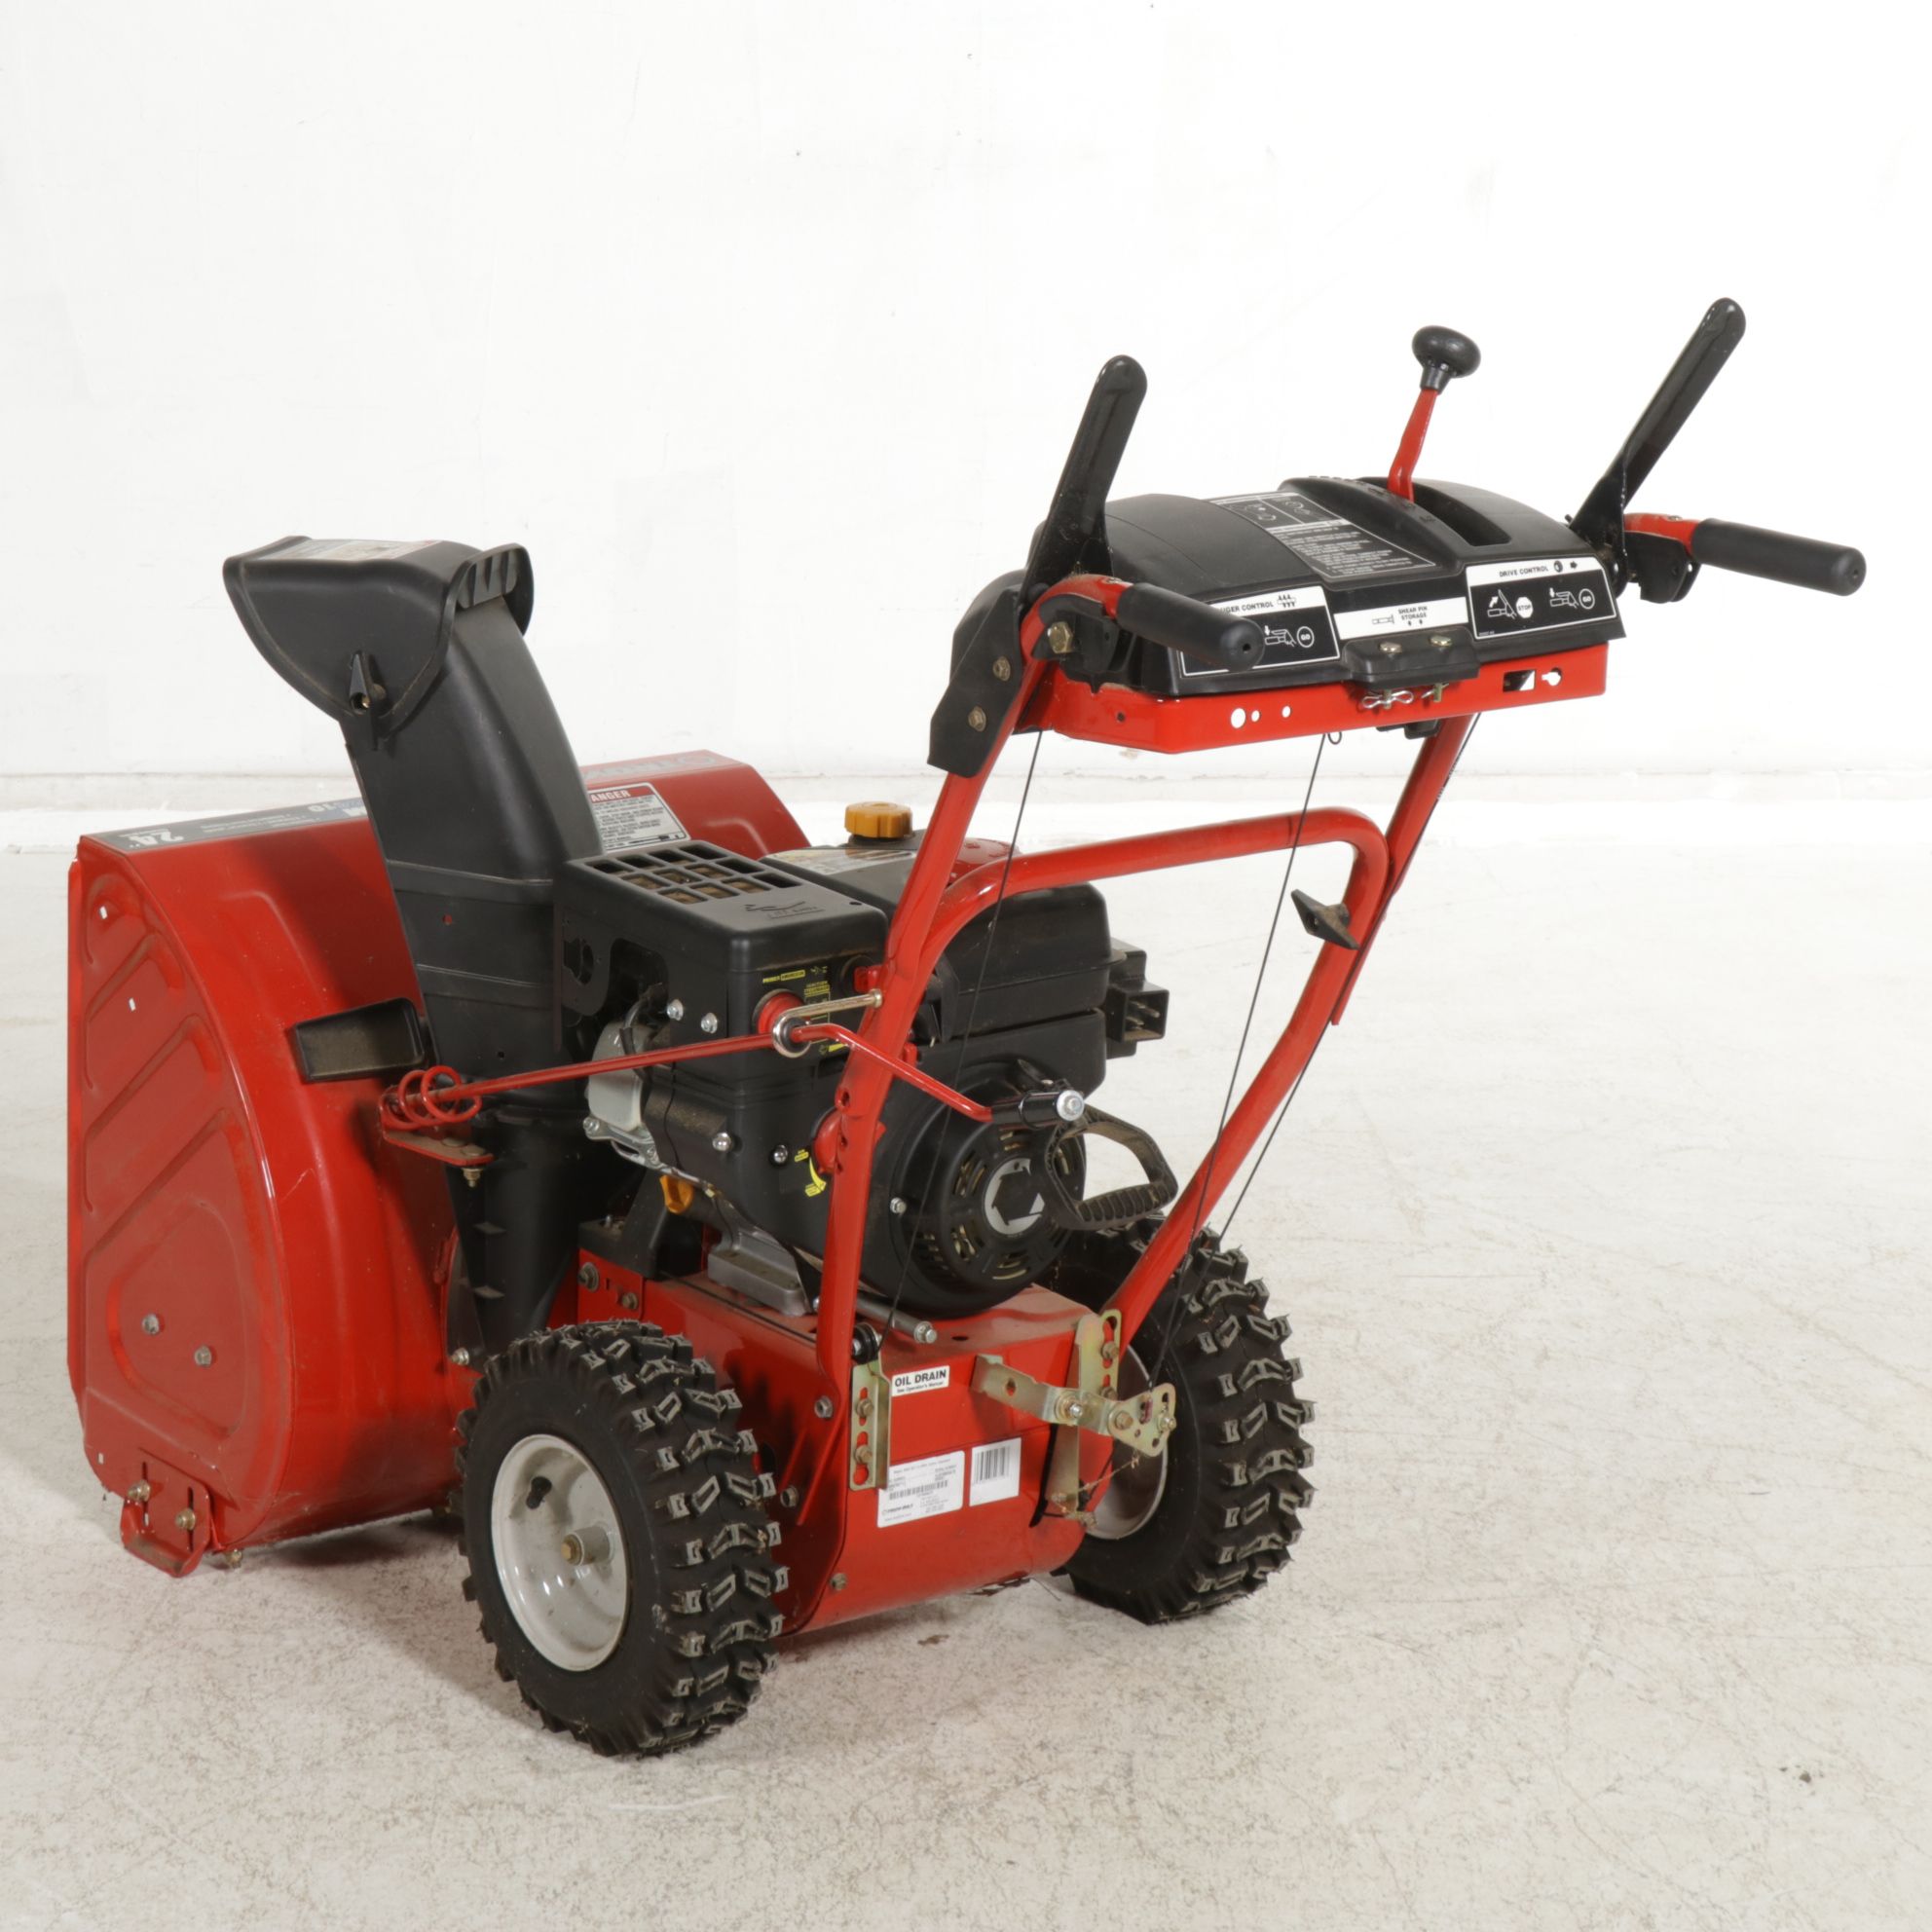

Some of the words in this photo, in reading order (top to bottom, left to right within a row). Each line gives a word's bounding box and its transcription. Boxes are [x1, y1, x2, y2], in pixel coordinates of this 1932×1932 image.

[1499, 569, 1518, 577] DRIVE
[1519, 565, 1549, 575] CONTROL
[1242, 601, 1275, 612] CONTROL
[1517, 603, 1532, 612] STOP
[1401, 612, 1427, 620] STORAGE
[590, 790, 631, 802] ANGER
[894, 1375, 911, 1388] OIL
[914, 1368, 947, 1384] DRAIN
